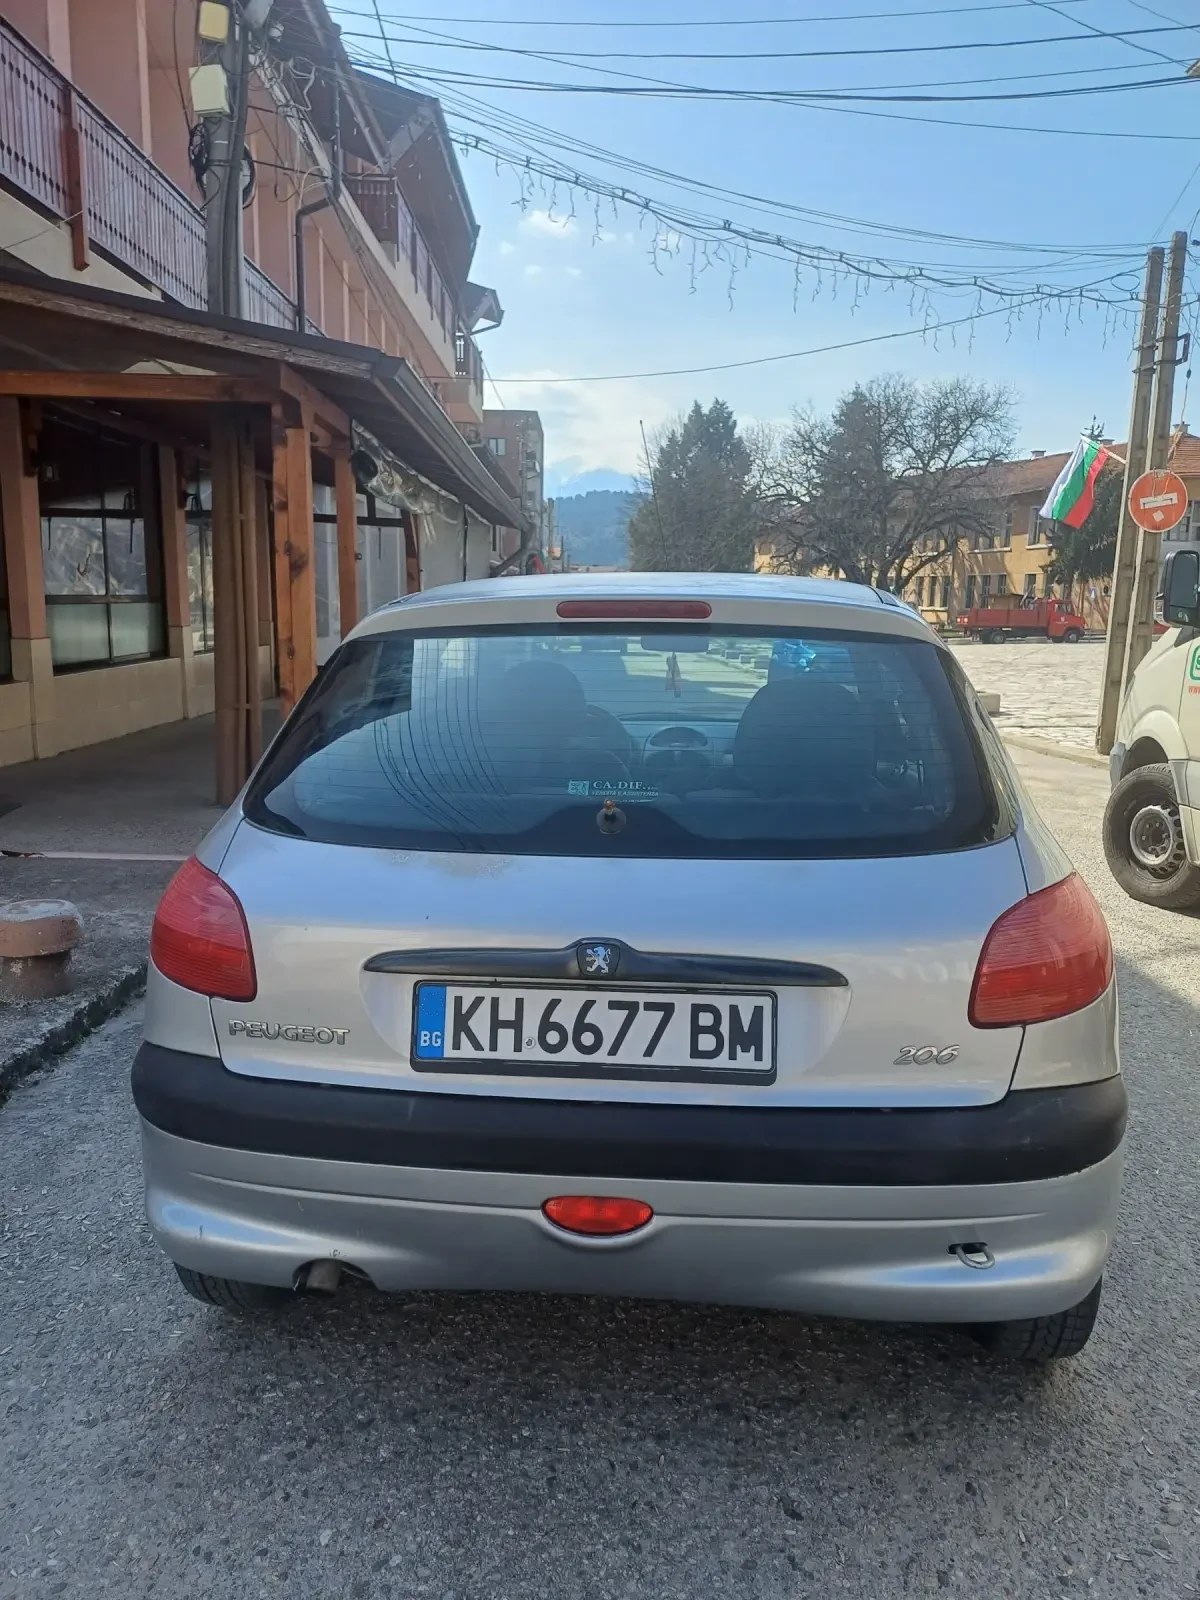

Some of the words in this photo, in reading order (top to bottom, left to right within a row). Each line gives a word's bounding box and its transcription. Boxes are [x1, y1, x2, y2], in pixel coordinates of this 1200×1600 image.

[228, 1019, 350, 1045] PEUGEOT
[420, 1030, 442, 1048] BG
[451, 995, 526, 1053] KH
[537, 998, 676, 1058] 6677
[689, 1003, 765, 1062] BM
[893, 1044, 960, 1066] 206
